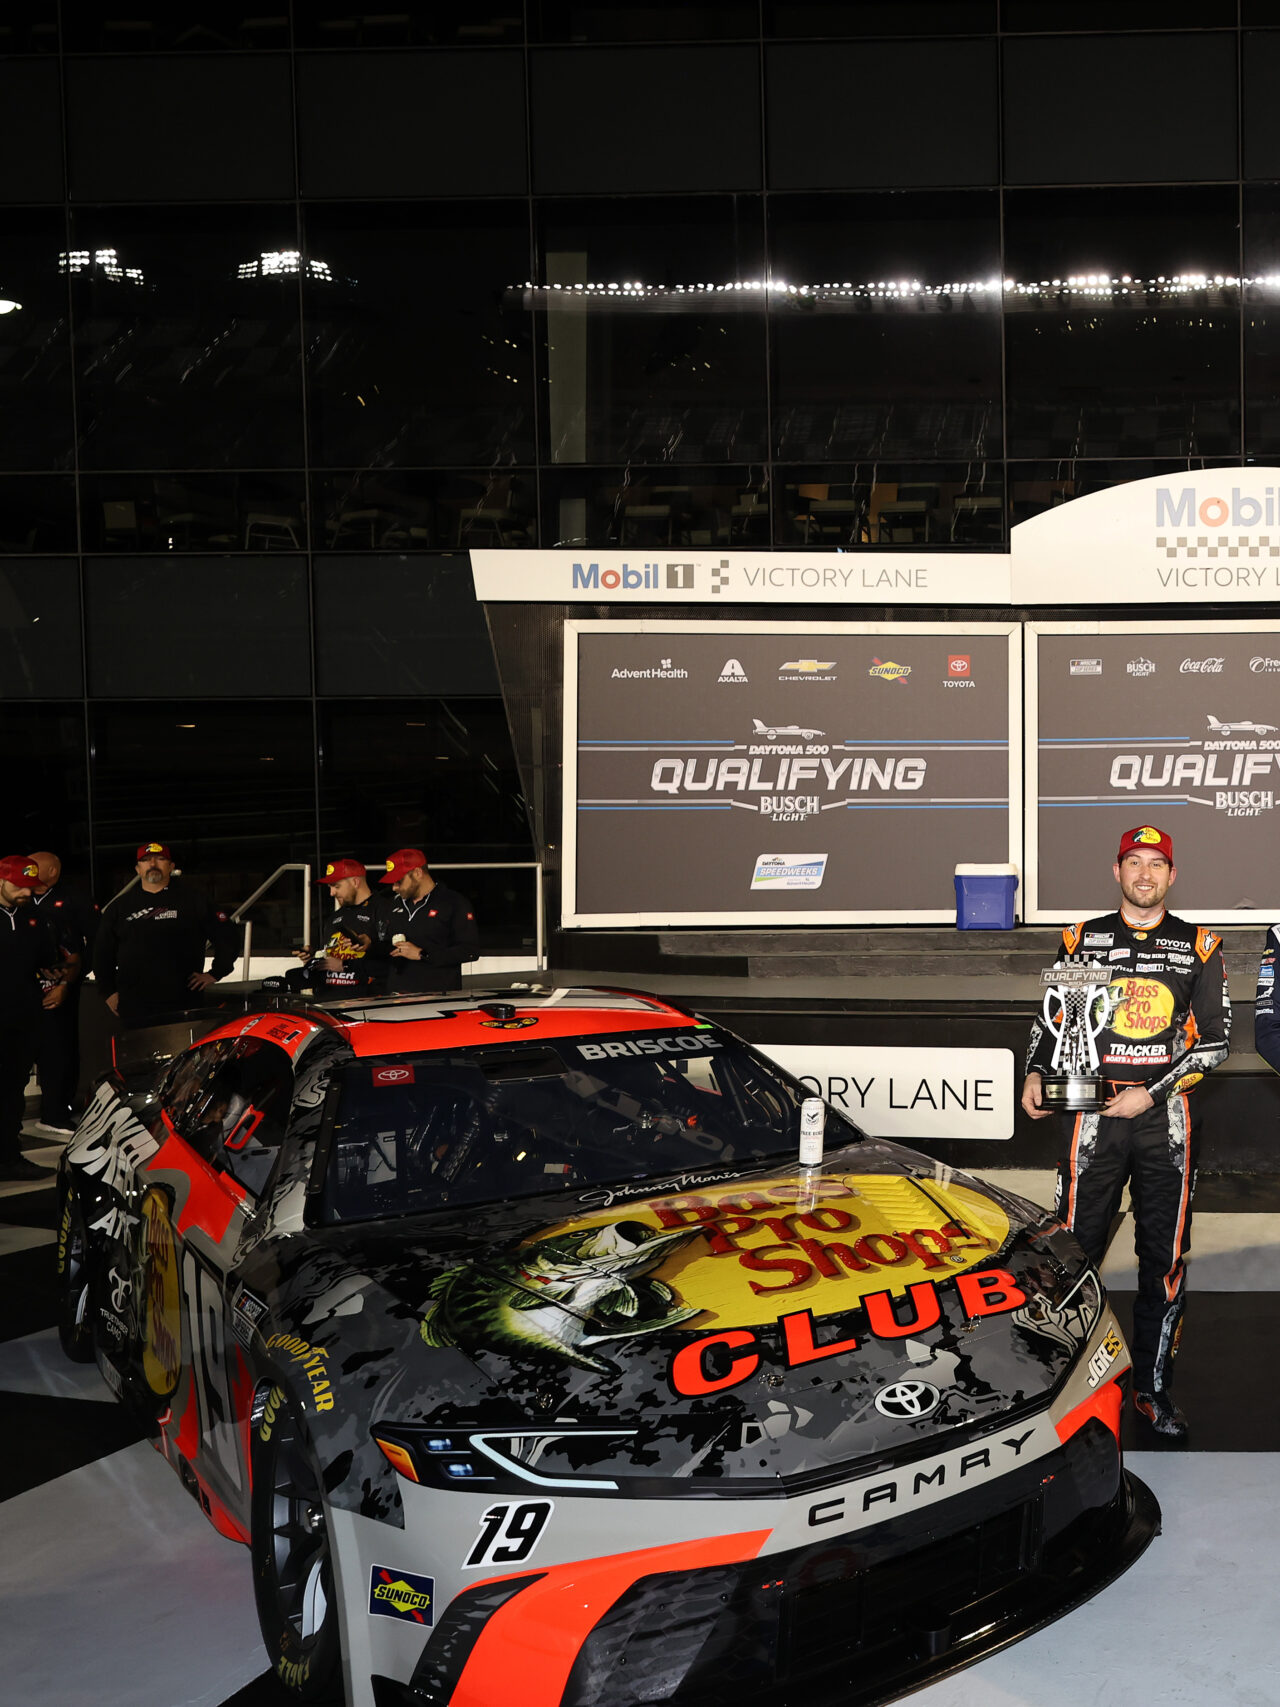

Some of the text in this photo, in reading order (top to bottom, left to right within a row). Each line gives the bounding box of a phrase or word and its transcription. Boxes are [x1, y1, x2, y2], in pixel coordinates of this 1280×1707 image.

[572, 563, 658, 590] Mobil
[743, 567, 928, 589] VICTORY LANE
[1156, 567, 1267, 588] VICTORY
[610, 667, 689, 680] AdventHealth
[870, 667, 910, 675] SUNOCO
[1126, 663, 1155, 673] BUSCH
[942, 680, 976, 688] TOYOTA
[749, 745, 829, 755] DAYTONA 500
[1203, 741, 1257, 751] DAYTONA
[650, 758, 927, 794] QUALIFYING
[759, 796, 820, 814] BUSCH
[1215, 791, 1274, 810] BUSCH
[772, 813, 807, 822] LIGHT
[1227, 808, 1261, 816] LIGHT
[760, 867, 818, 876] SPEEDWEEKS
[1155, 939, 1191, 950] TOYOTA
[1044, 972, 1108, 982] QUALIFYING
[1124, 980, 1159, 998] Bass
[1124, 997, 1151, 1012] Pro
[1124, 1013, 1168, 1034] Shops
[576, 1034, 725, 1061] BRISCOE
[1109, 1043, 1167, 1057] TRACKER
[1132, 1057, 1145, 1065] OFF
[1146, 1056, 1170, 1064] ROAD
[888, 1077, 994, 1112] LANE
[579, 1181, 681, 1206] Johnny
[641, 1178, 860, 1230] Bass
[698, 1206, 852, 1257] Pro
[738, 1219, 992, 1296] Shops
[670, 1268, 1028, 1397] CLUB
[266, 1332, 336, 1413] GOODYEAR
[808, 1428, 1036, 1527] CAMRY
[466, 1501, 552, 1566] 19
[376, 1585, 430, 1608] SUNOCO
